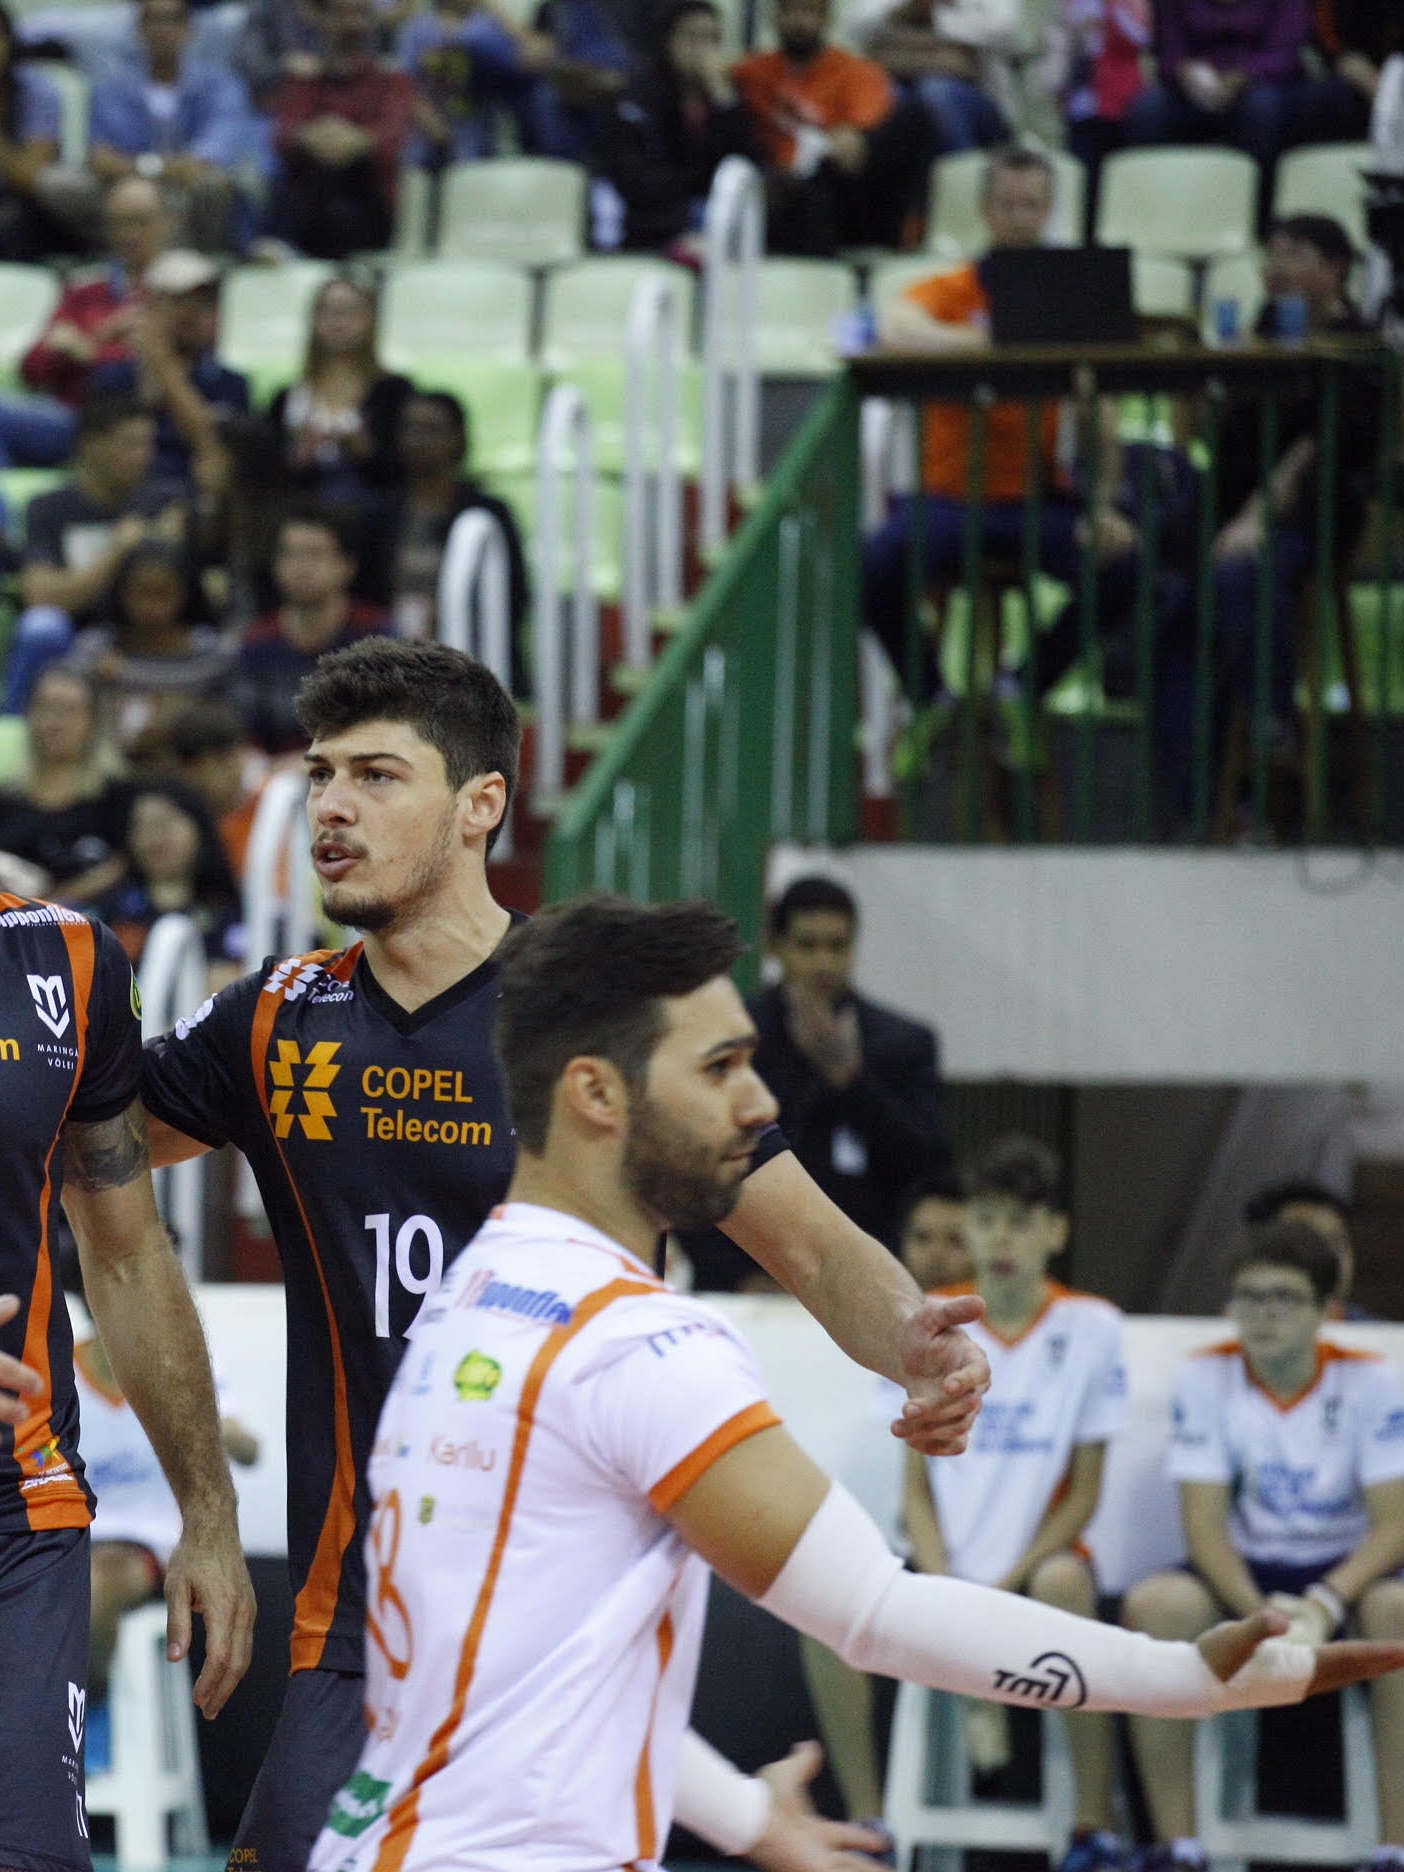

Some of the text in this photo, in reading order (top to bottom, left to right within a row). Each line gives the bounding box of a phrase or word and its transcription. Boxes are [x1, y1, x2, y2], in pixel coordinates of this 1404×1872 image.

[361, 1065, 473, 1103] COPEL
[361, 1107, 492, 1146] Telecom
[364, 1213, 445, 1339] 19
